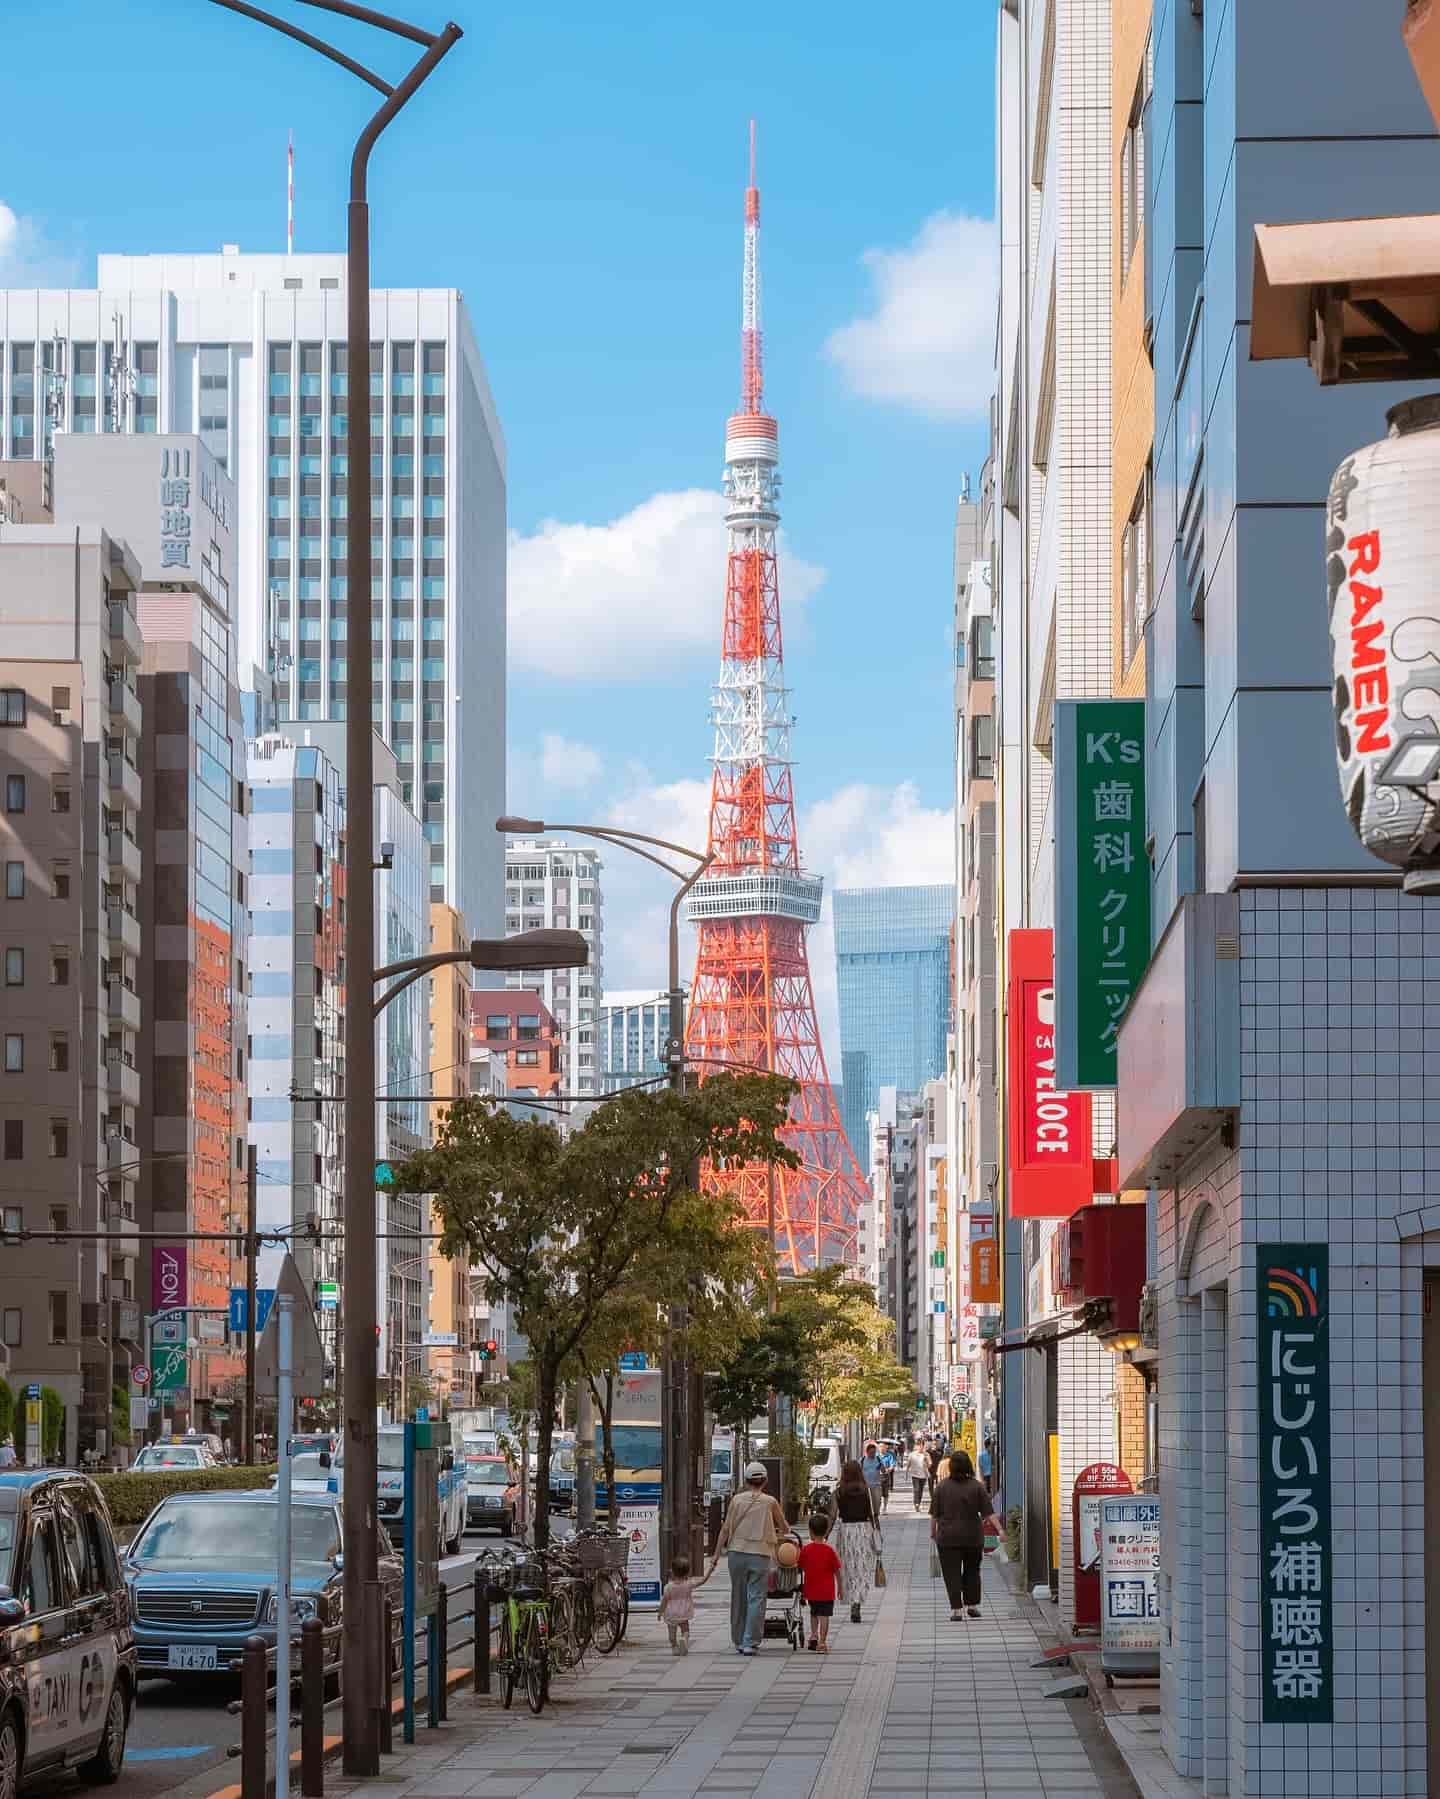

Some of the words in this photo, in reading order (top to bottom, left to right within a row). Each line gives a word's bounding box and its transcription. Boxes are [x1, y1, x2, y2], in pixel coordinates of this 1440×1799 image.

[160, 447, 191, 569] 川崎地質
[1346, 528, 1392, 754] RAMEN
[1270, 1328, 1324, 1699] にじいろ補聴器
[46, 1671, 71, 1720] TAXI
